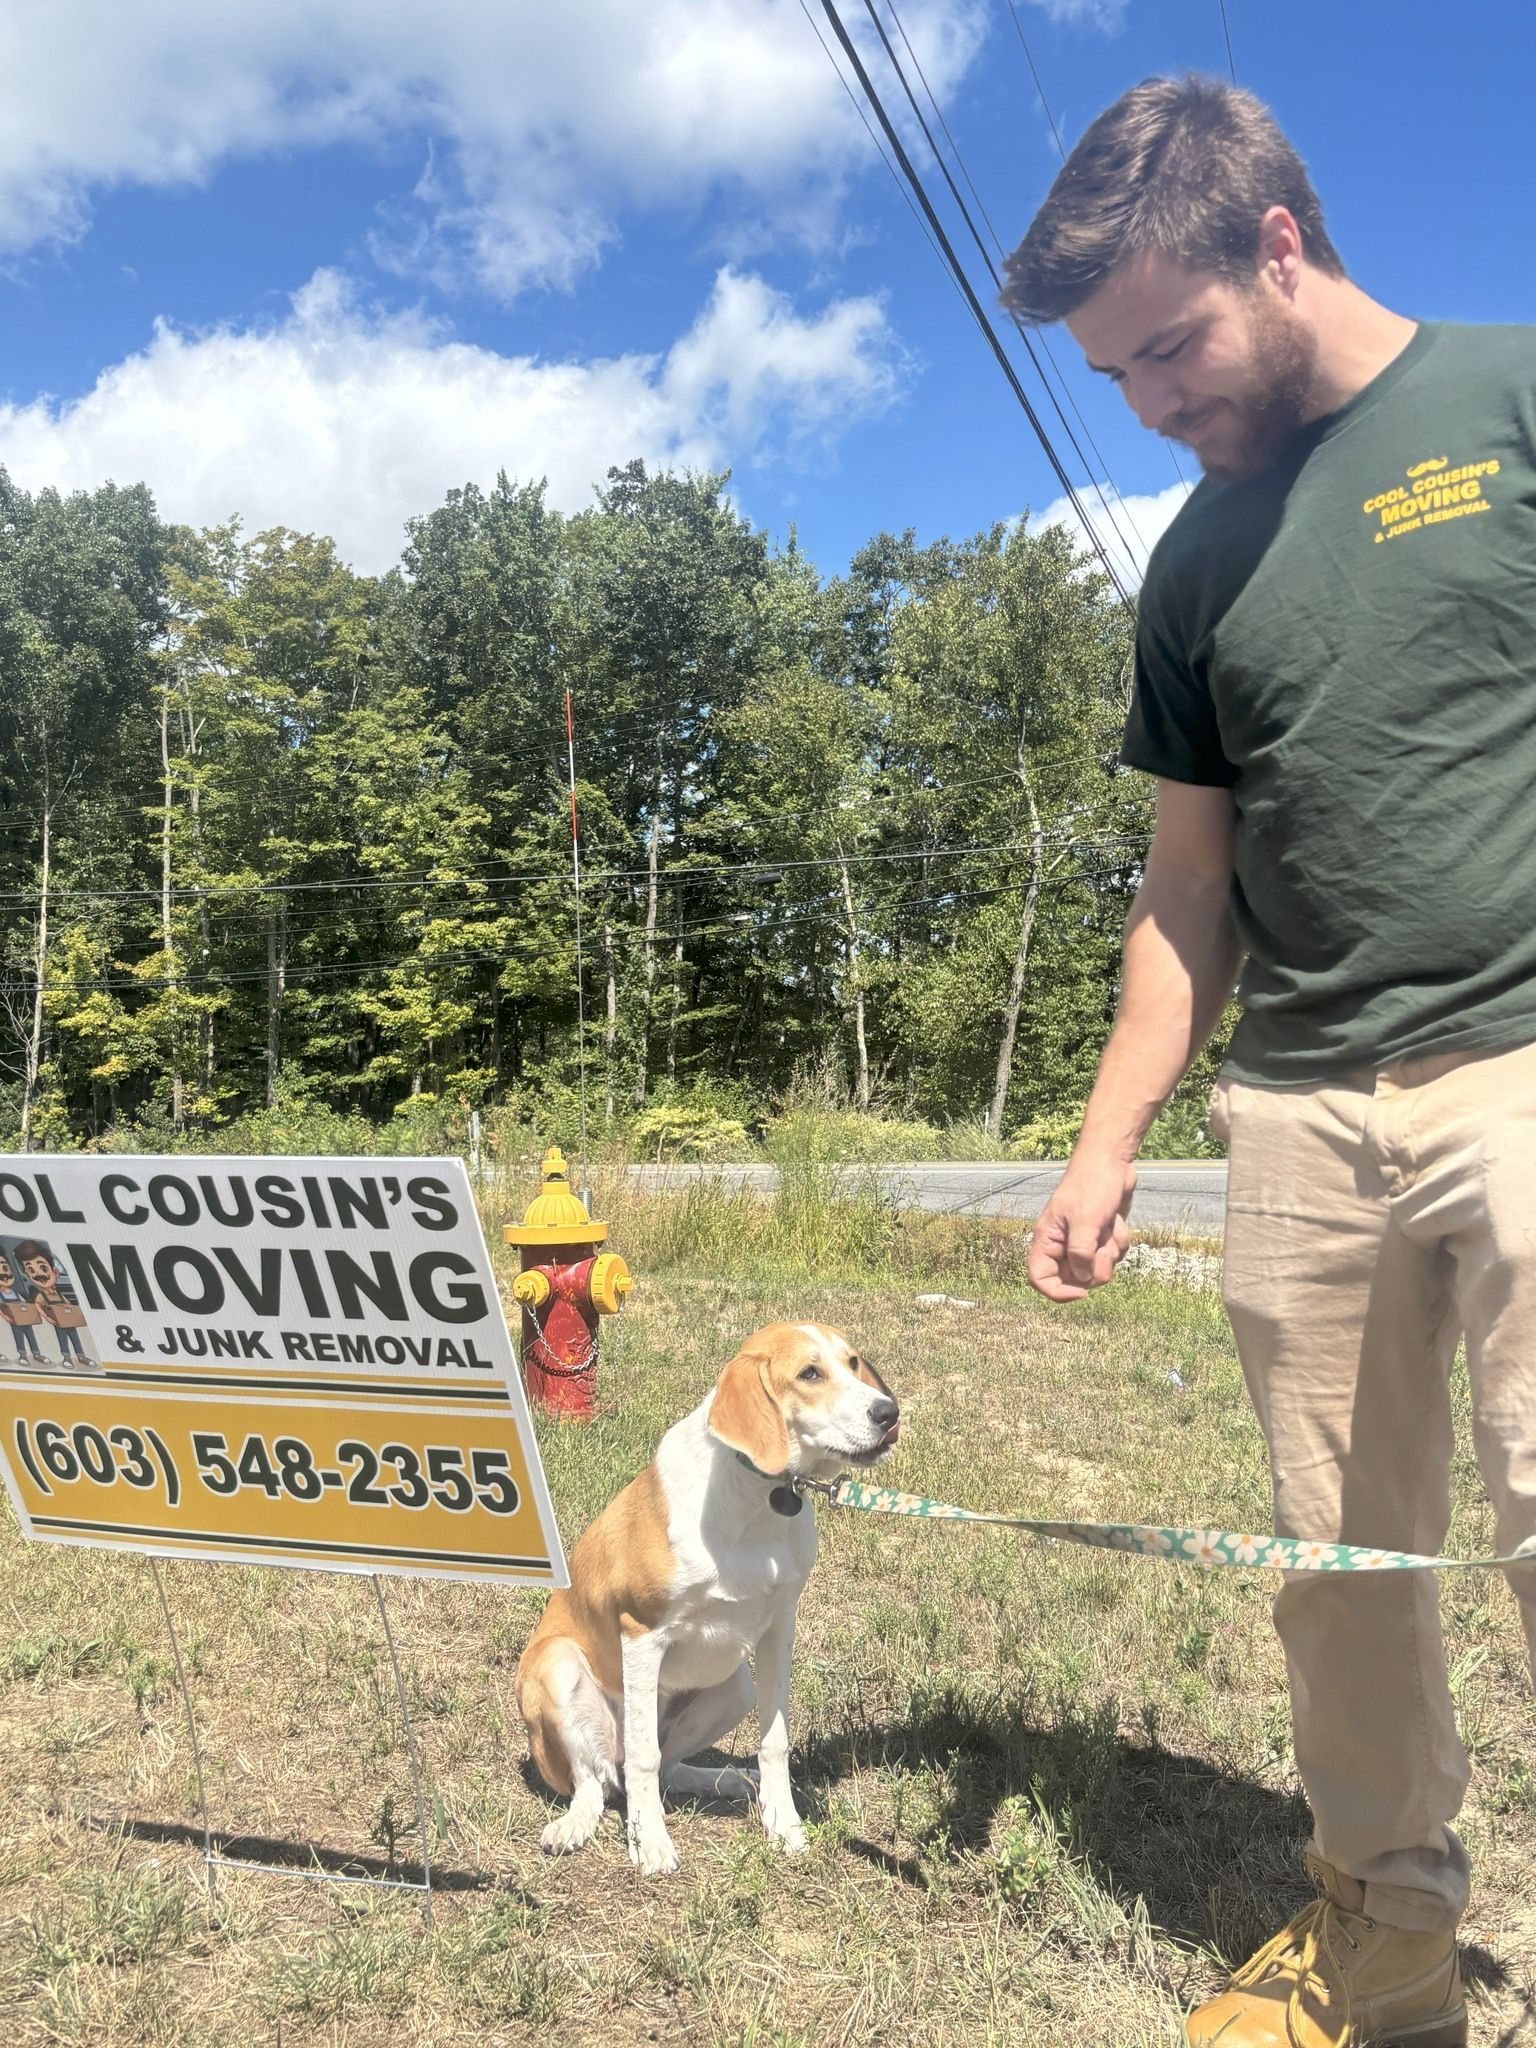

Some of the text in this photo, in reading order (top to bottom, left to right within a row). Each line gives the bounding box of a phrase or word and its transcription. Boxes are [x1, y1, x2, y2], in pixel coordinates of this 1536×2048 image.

[1363, 460, 1500, 513] COOL COUSIN'S
[1381, 480, 1481, 526] MOVING
[1374, 500, 1491, 543] & JUNK REMOVAL
[99, 1174, 459, 1232] COUSIN'S
[66, 1243, 489, 1324] MOVING
[115, 1324, 493, 1369] & JUNK REMOVAL
[14, 1418, 521, 1514] (603) 548-2355
